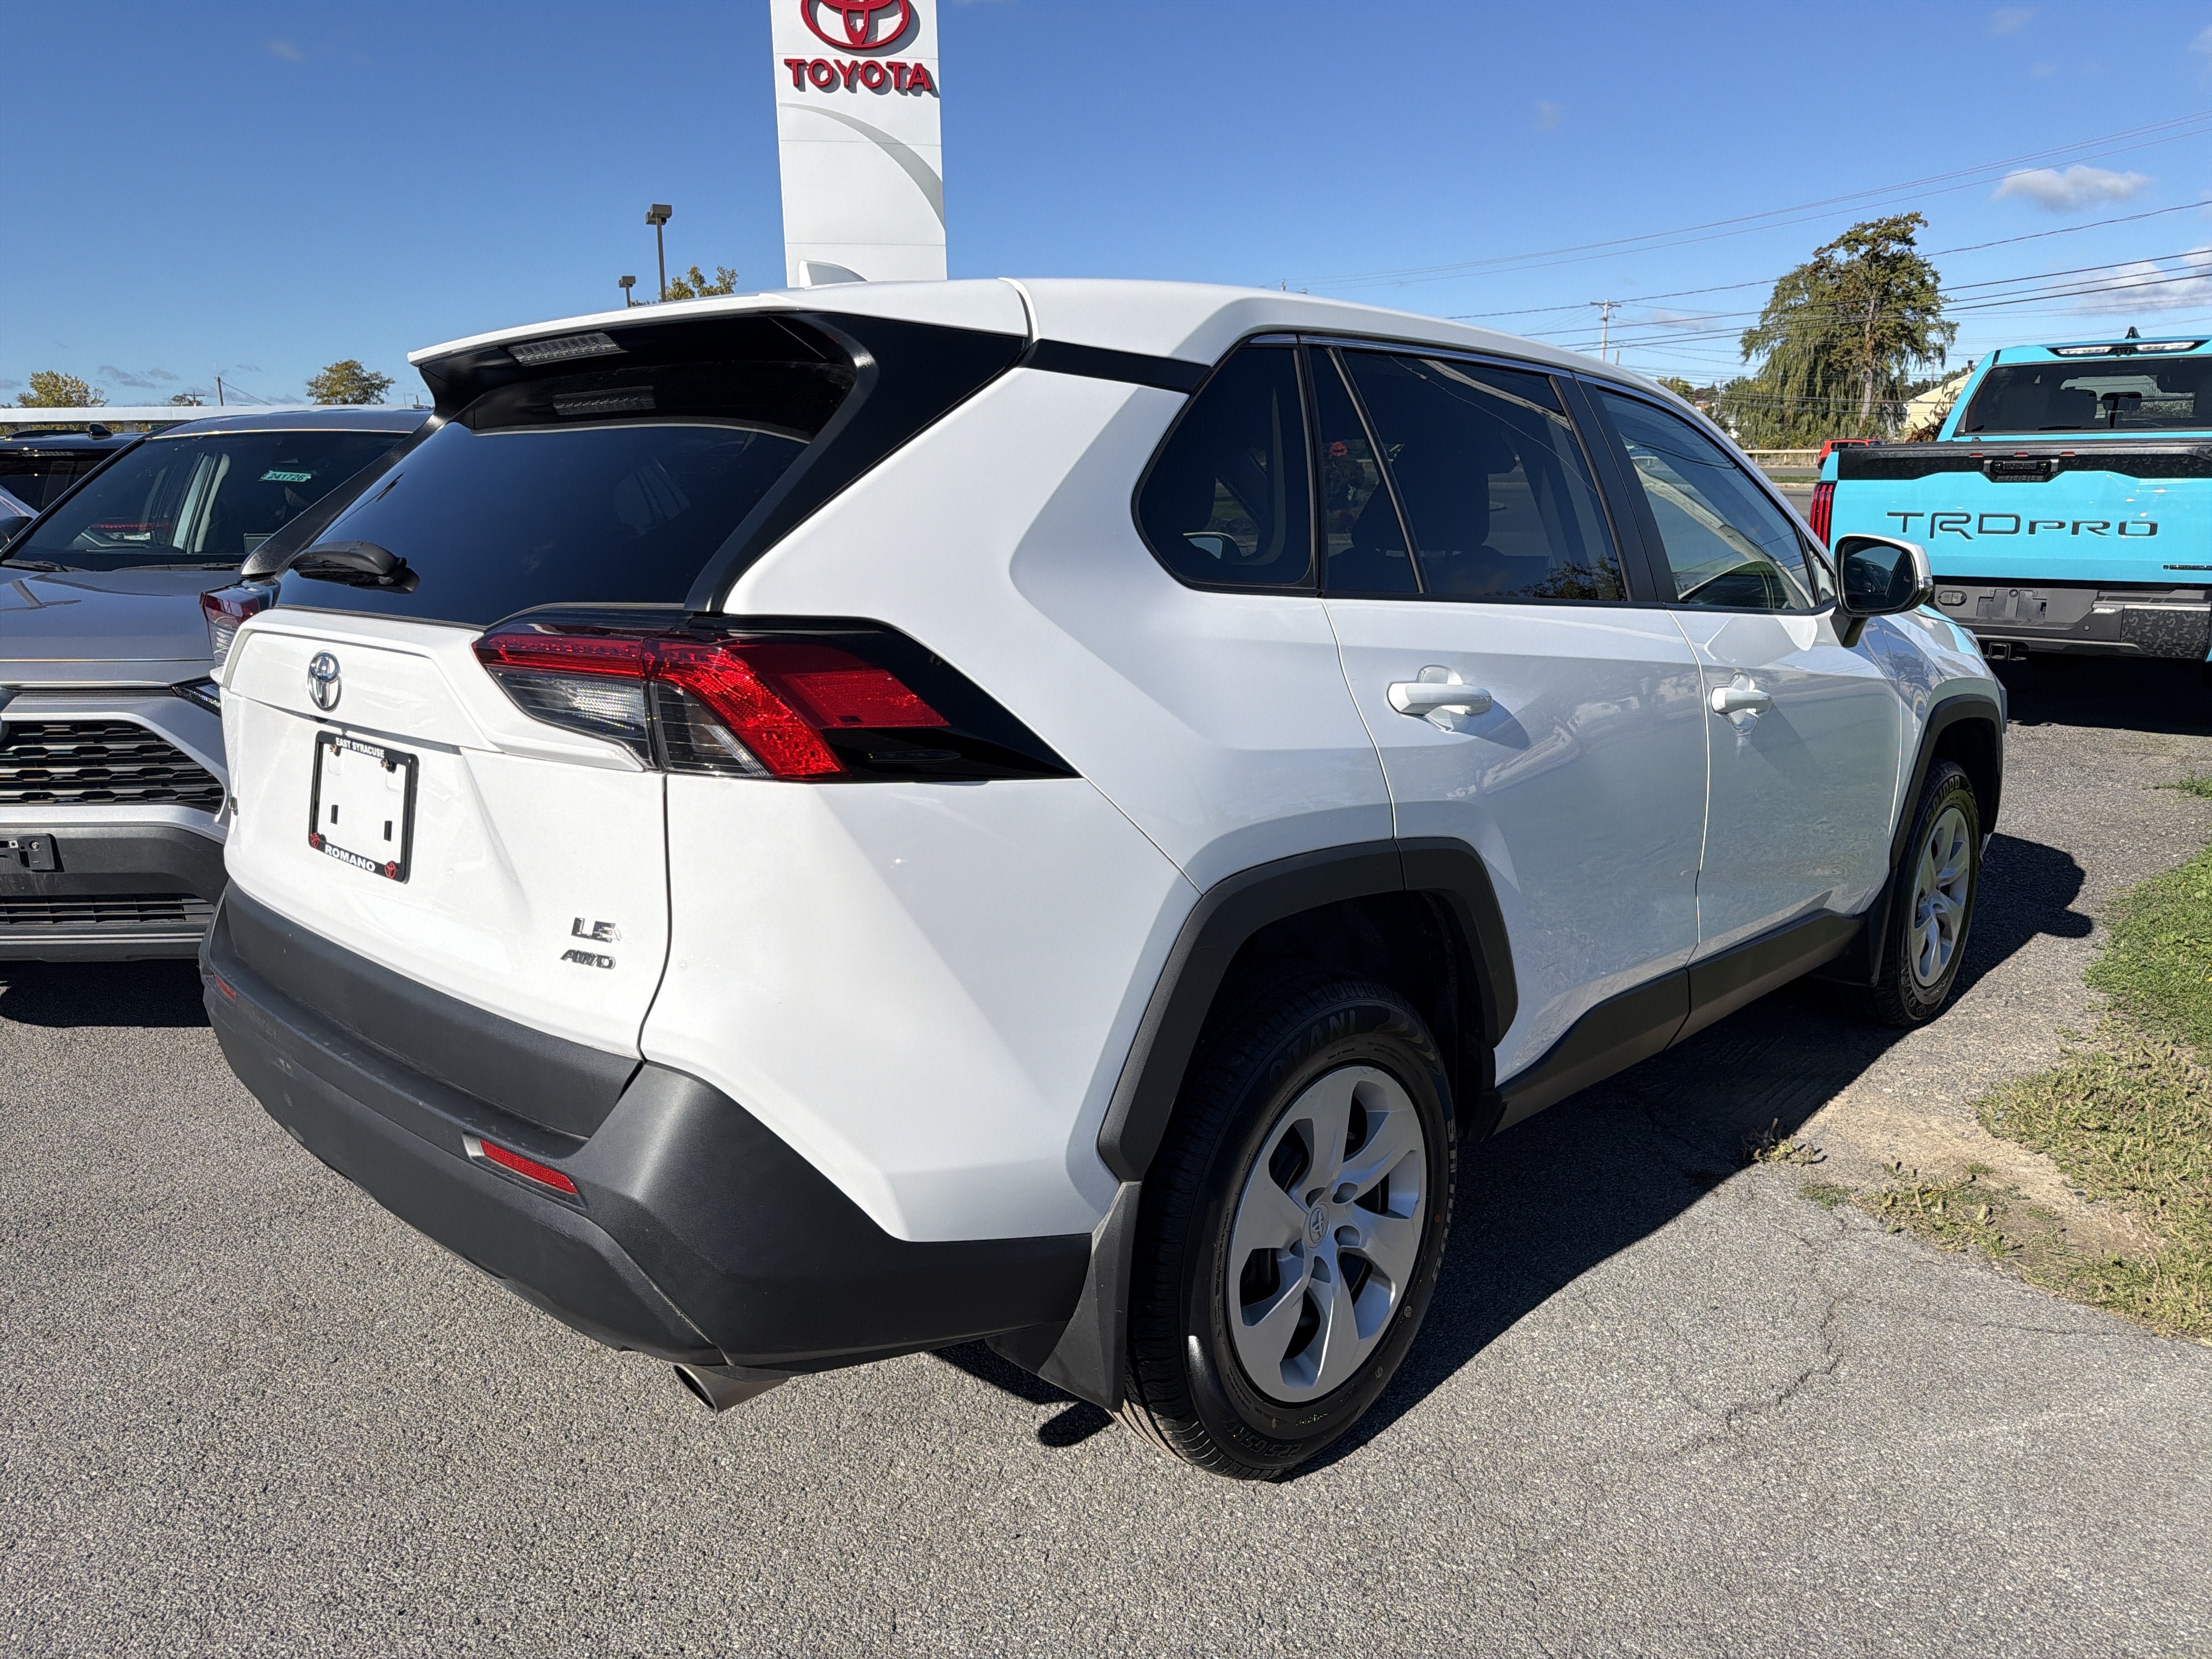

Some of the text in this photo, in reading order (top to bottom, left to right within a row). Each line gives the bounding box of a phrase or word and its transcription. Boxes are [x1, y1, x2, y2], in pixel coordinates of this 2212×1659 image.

[783, 58, 933, 90] TOYOTA
[335, 737, 385, 758] EAST SYRACUSE
[325, 843, 376, 872] ROMANO
[571, 917, 616, 943] LE
[560, 949, 616, 970] AWD
